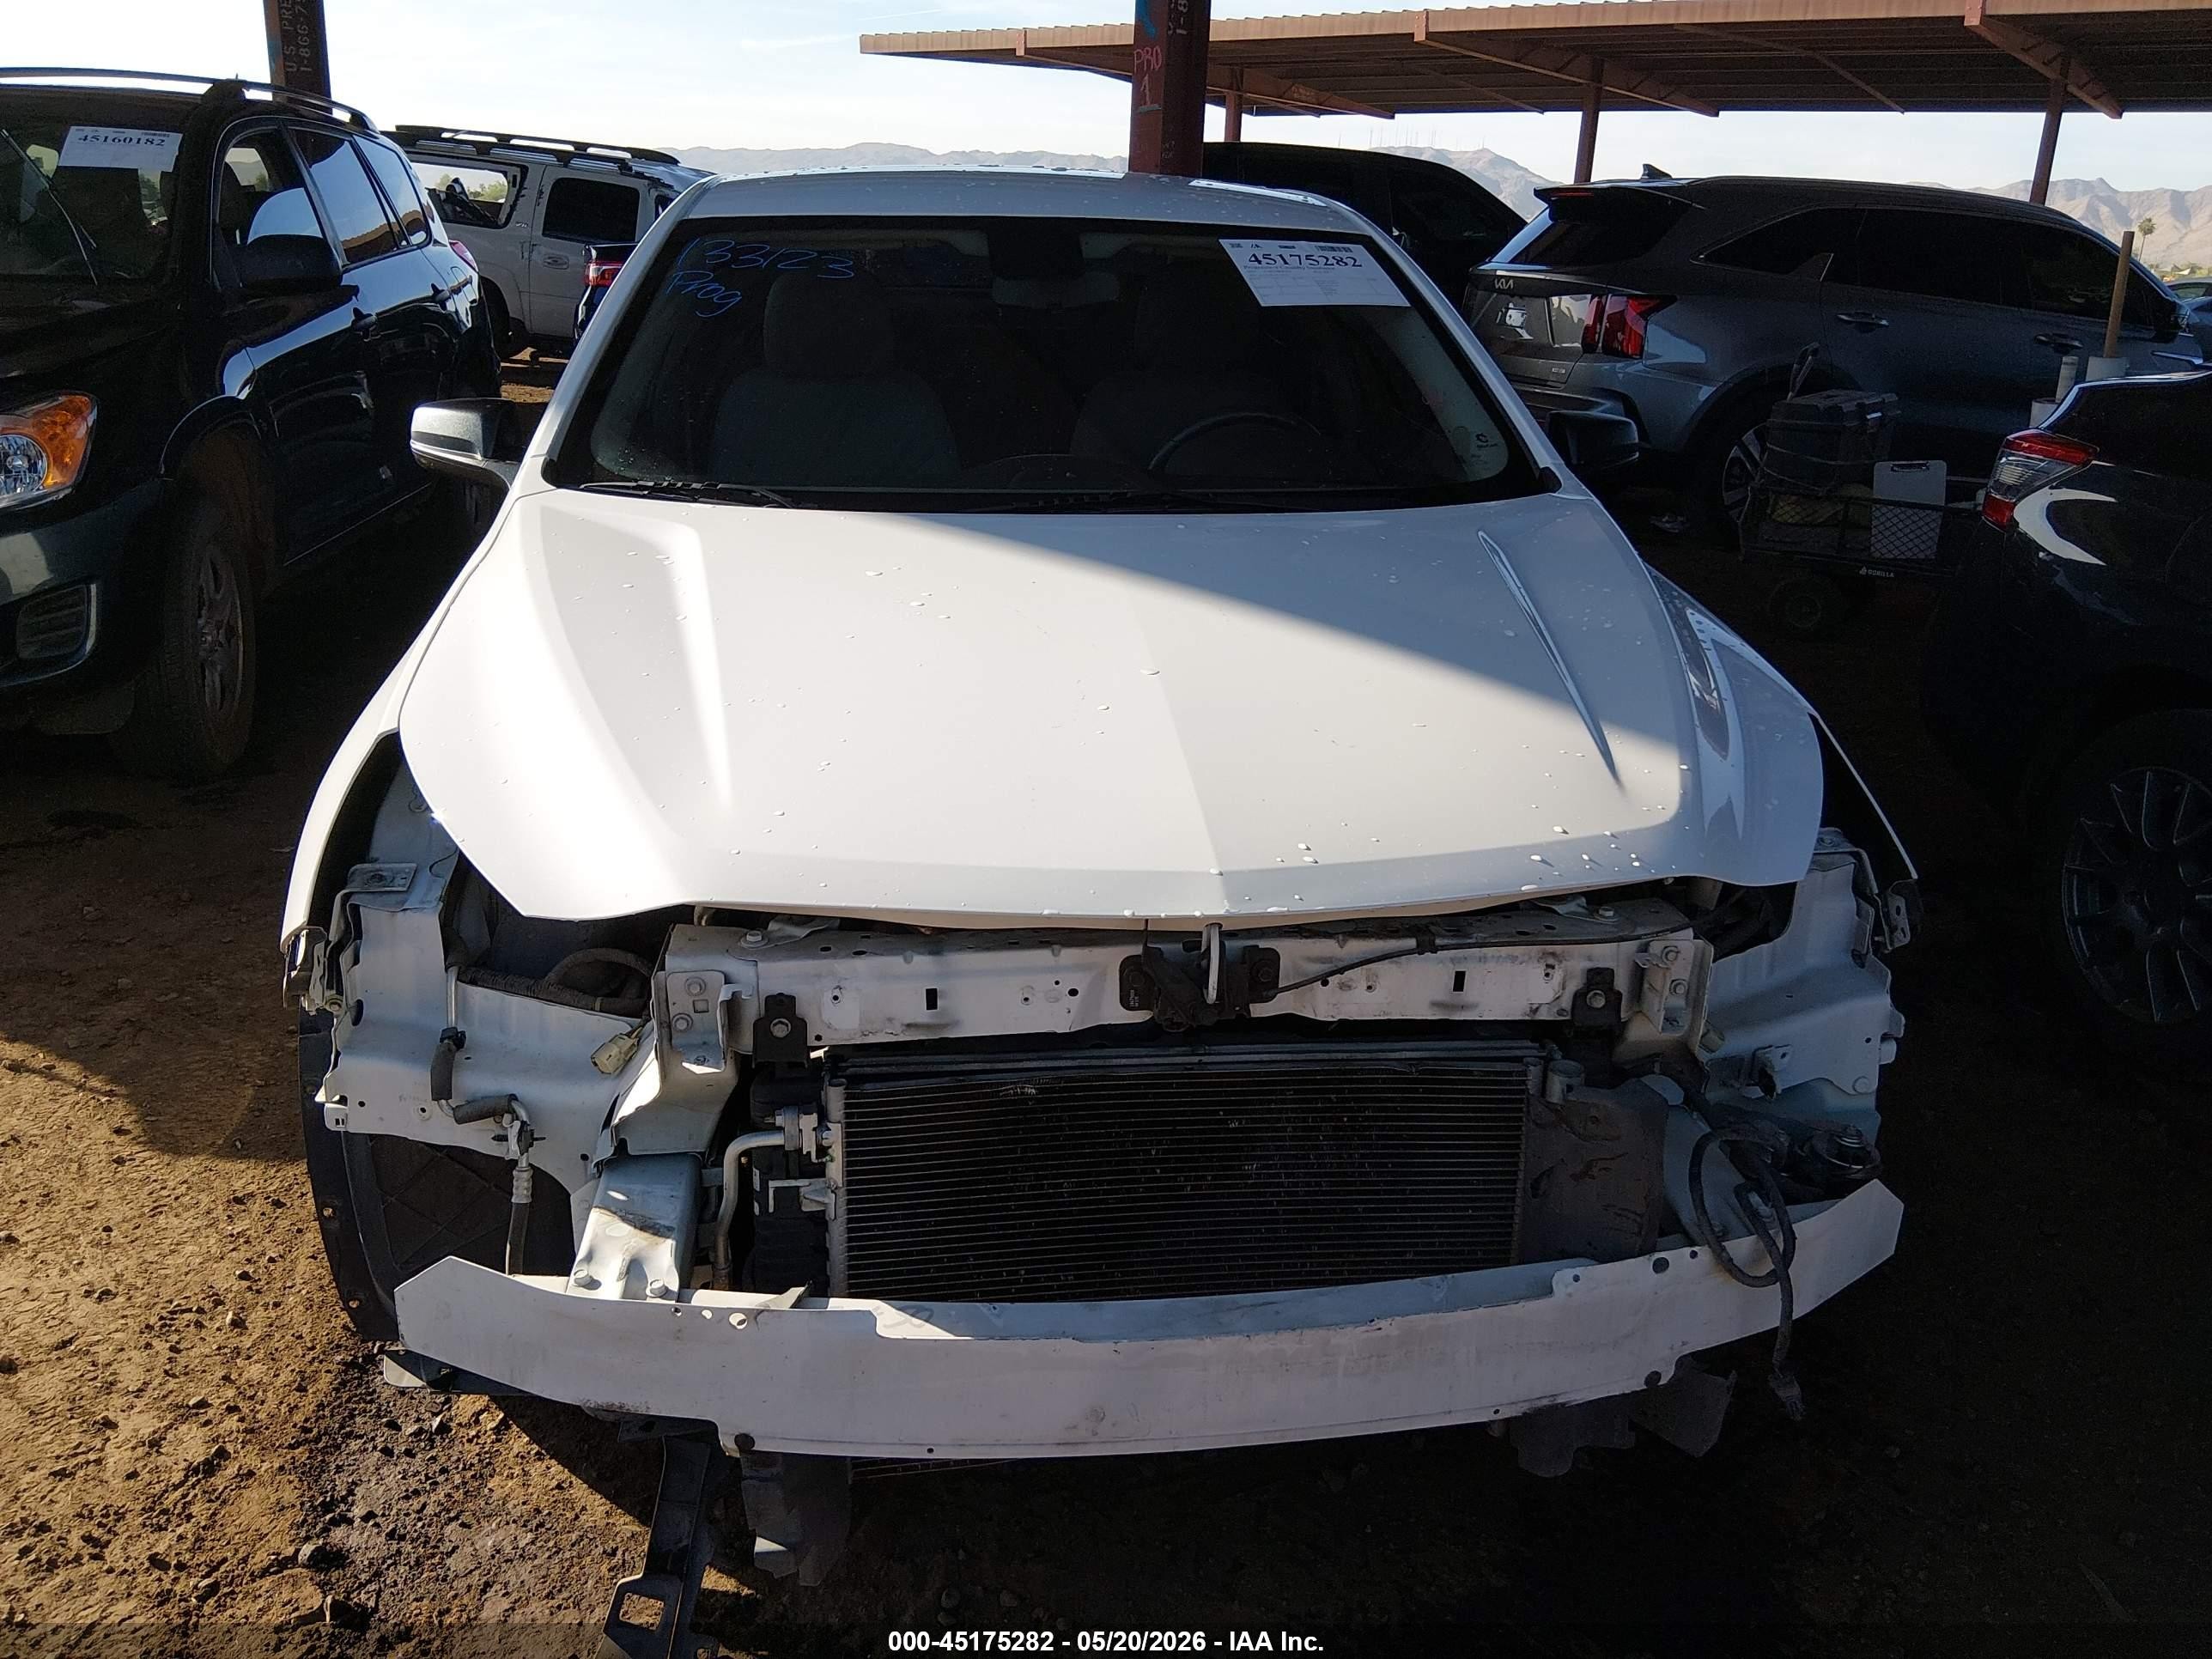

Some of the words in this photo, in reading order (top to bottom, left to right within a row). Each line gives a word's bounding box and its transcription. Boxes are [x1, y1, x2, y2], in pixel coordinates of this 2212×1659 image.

[1133, 46, 1162, 73] PRO
[78, 134, 167, 147] 45160182
[1248, 252, 1363, 269] 45175282
[1494, 277, 1514, 290] KIA
[666, 270, 743, 318] Prog
